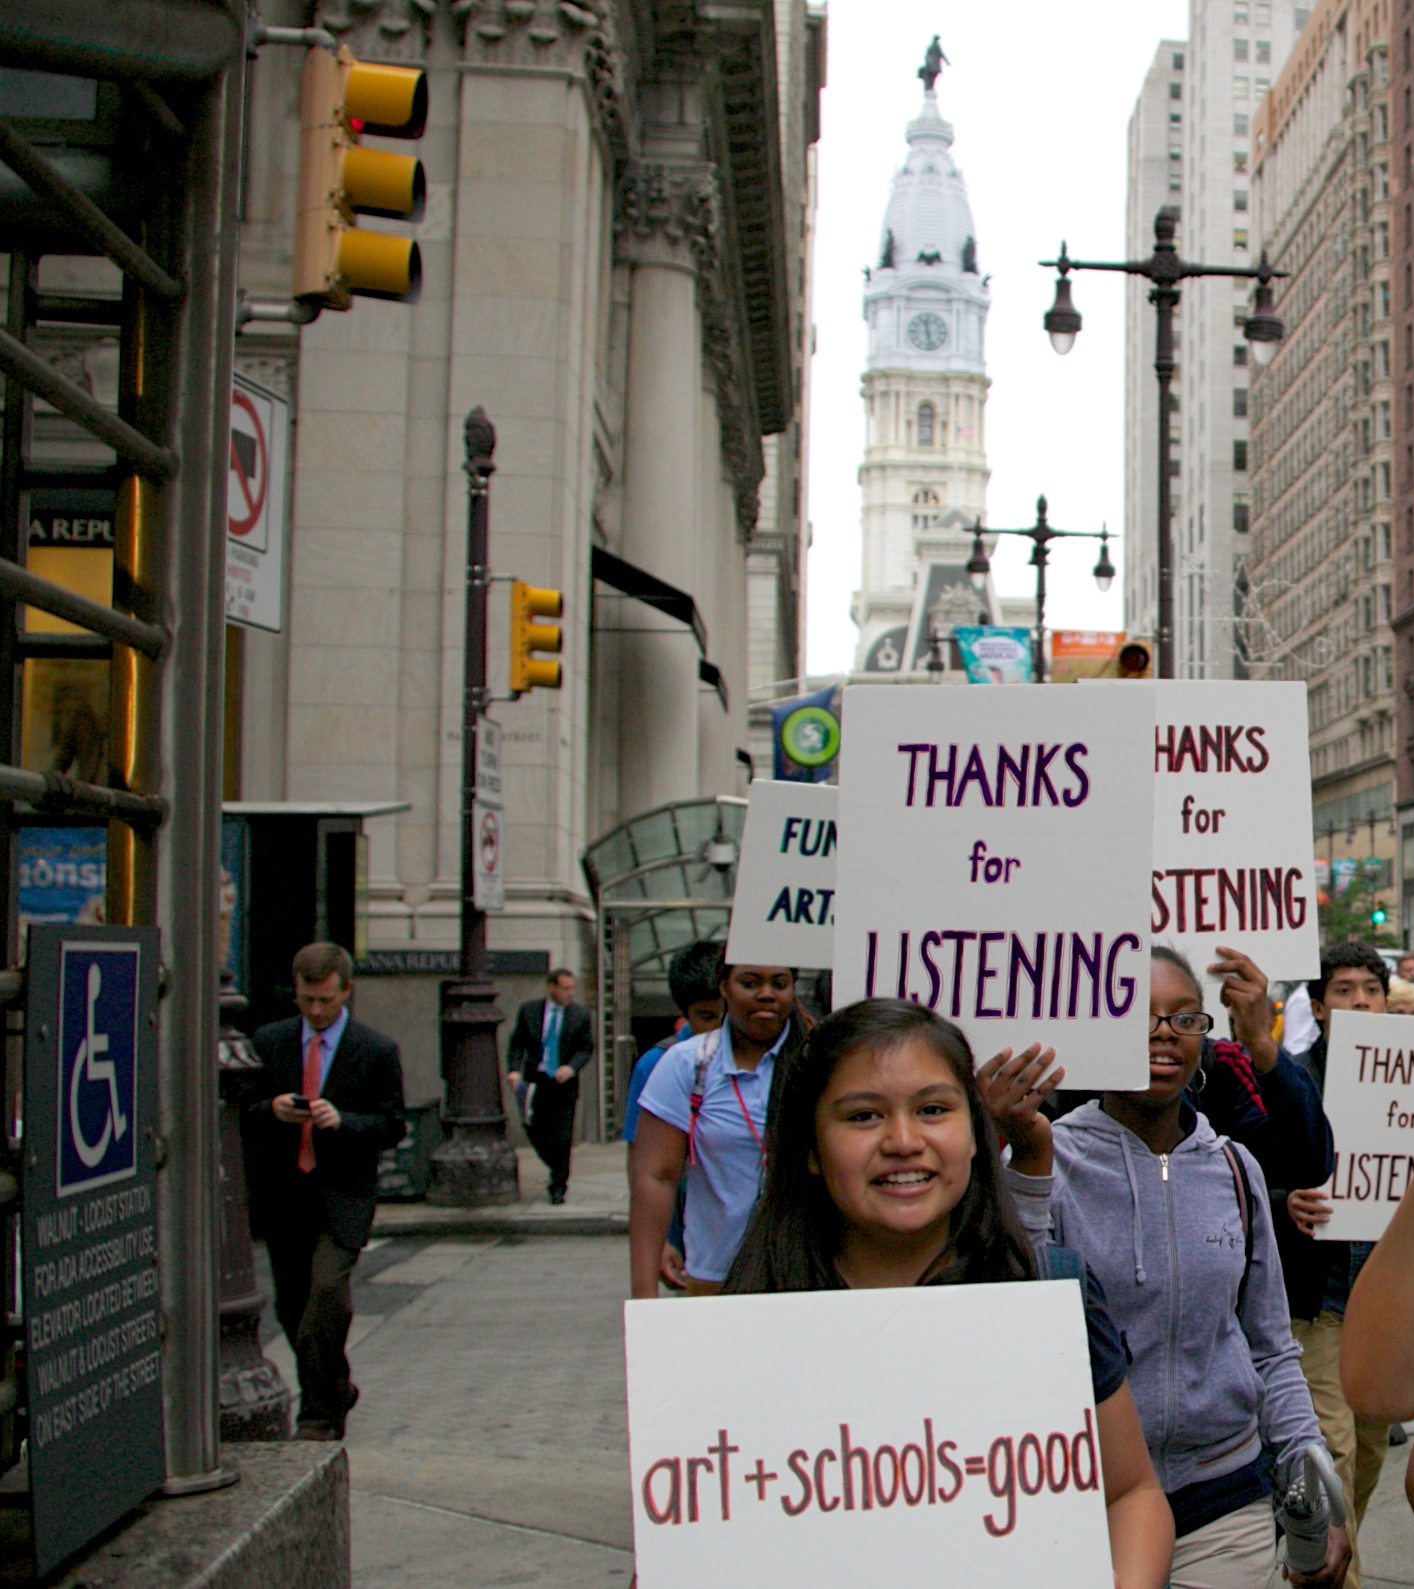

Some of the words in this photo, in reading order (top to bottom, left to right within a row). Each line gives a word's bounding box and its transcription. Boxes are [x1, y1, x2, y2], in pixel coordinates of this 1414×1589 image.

[898, 742, 1091, 808] THANKS
[1154, 724, 1270, 774] HANKS
[779, 816, 838, 857] FUN
[1181, 794, 1227, 834] for
[967, 838, 1022, 884] for
[765, 886, 835, 927] ART
[1151, 867, 1307, 934] STENING
[864, 929, 1143, 1021] LISTENING
[37, 1205, 79, 1246] WALNUT
[85, 1194, 118, 1232] LOCUST
[119, 1184, 150, 1220] STATION
[34, 1262, 57, 1298] FOR
[58, 1255, 77, 1290] ADA
[79, 1232, 138, 1281] ACCESSIBILITY
[30, 1299, 81, 1351] ELEVATOR
[82, 1284, 121, 1326] LOCATED
[122, 1266, 158, 1308] BETWEEN
[38, 1349, 78, 1397] WALNUT
[87, 1328, 120, 1372] LOCUST
[120, 1310, 156, 1353] STREETS
[36, 1411, 53, 1447] ON
[53, 1397, 77, 1441] EAST
[78, 1384, 99, 1423] SIDE
[100, 1377, 112, 1409] OF
[112, 1366, 129, 1400] THE
[130, 1351, 160, 1392] STREET
